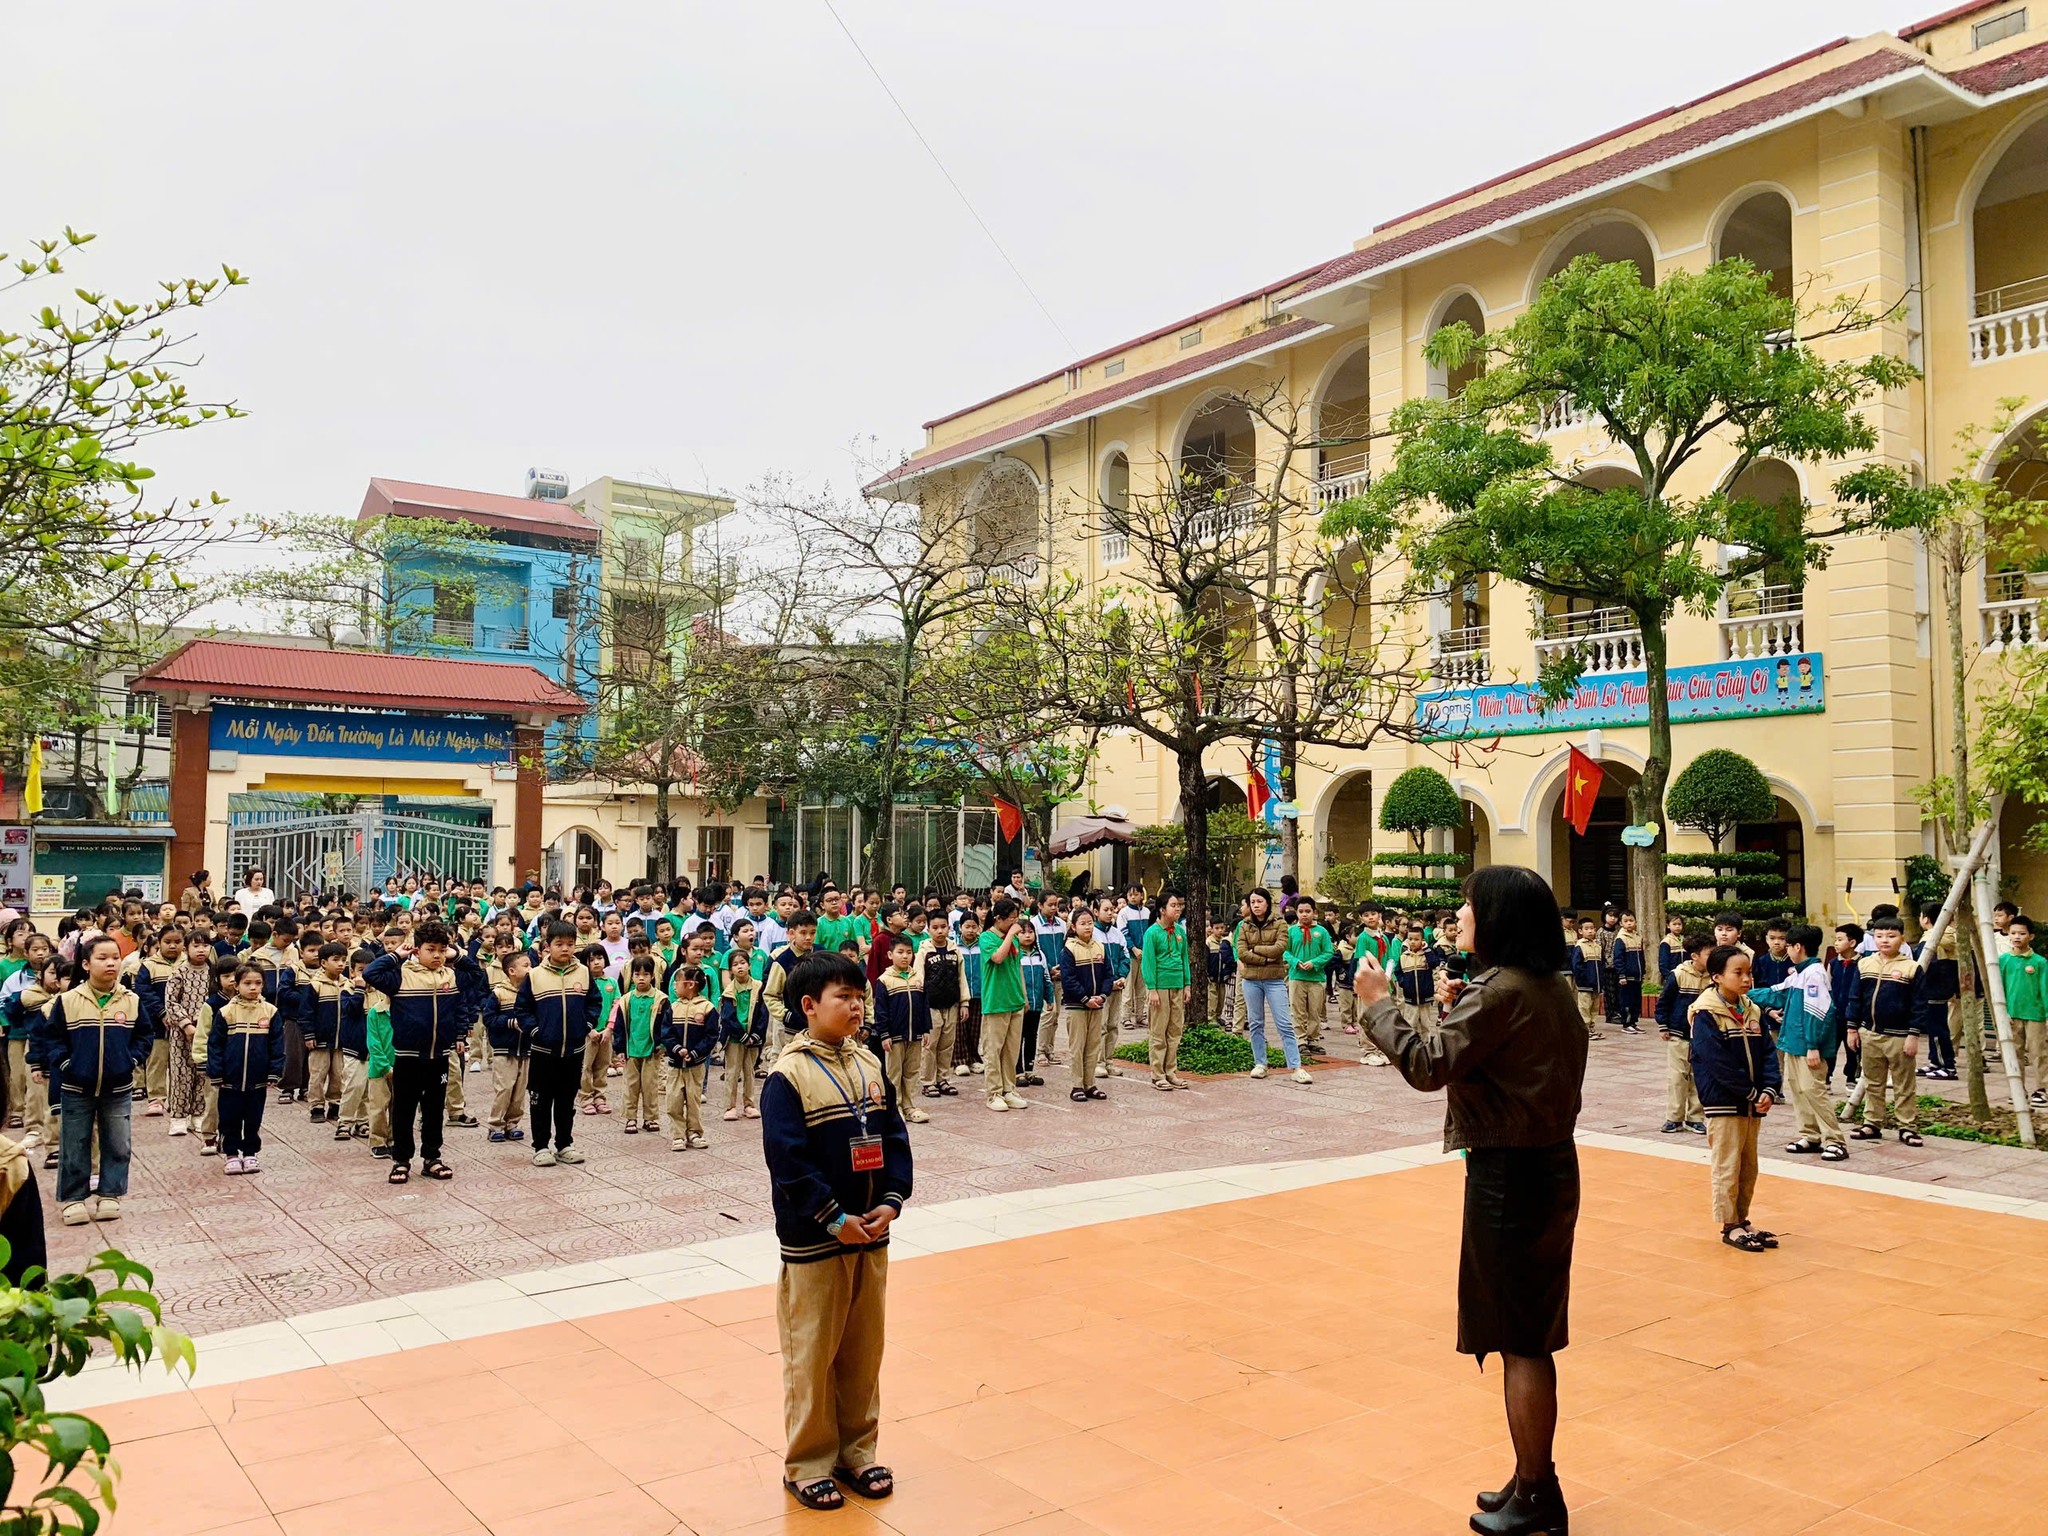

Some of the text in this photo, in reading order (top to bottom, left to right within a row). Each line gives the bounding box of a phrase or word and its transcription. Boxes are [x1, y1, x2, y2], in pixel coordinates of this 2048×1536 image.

[1477, 691, 1503, 719] Niềm
[1505, 693, 1523, 716] Vui
[1574, 684, 1598, 710] Sinh
[1601, 682, 1618, 708] Là
[1688, 673, 1712, 700] Của
[1715, 666, 1747, 703] Thầy
[1750, 667, 1770, 695] Cô
[226, 718, 259, 739] Mỗi
[262, 720, 303, 746] Ngày
[307, 722, 334, 743] Đến
[338, 724, 384, 750] Trường
[388, 727, 405, 746] Là
[409, 728, 442, 752] Một
[444, 730, 480, 754] Ngày
